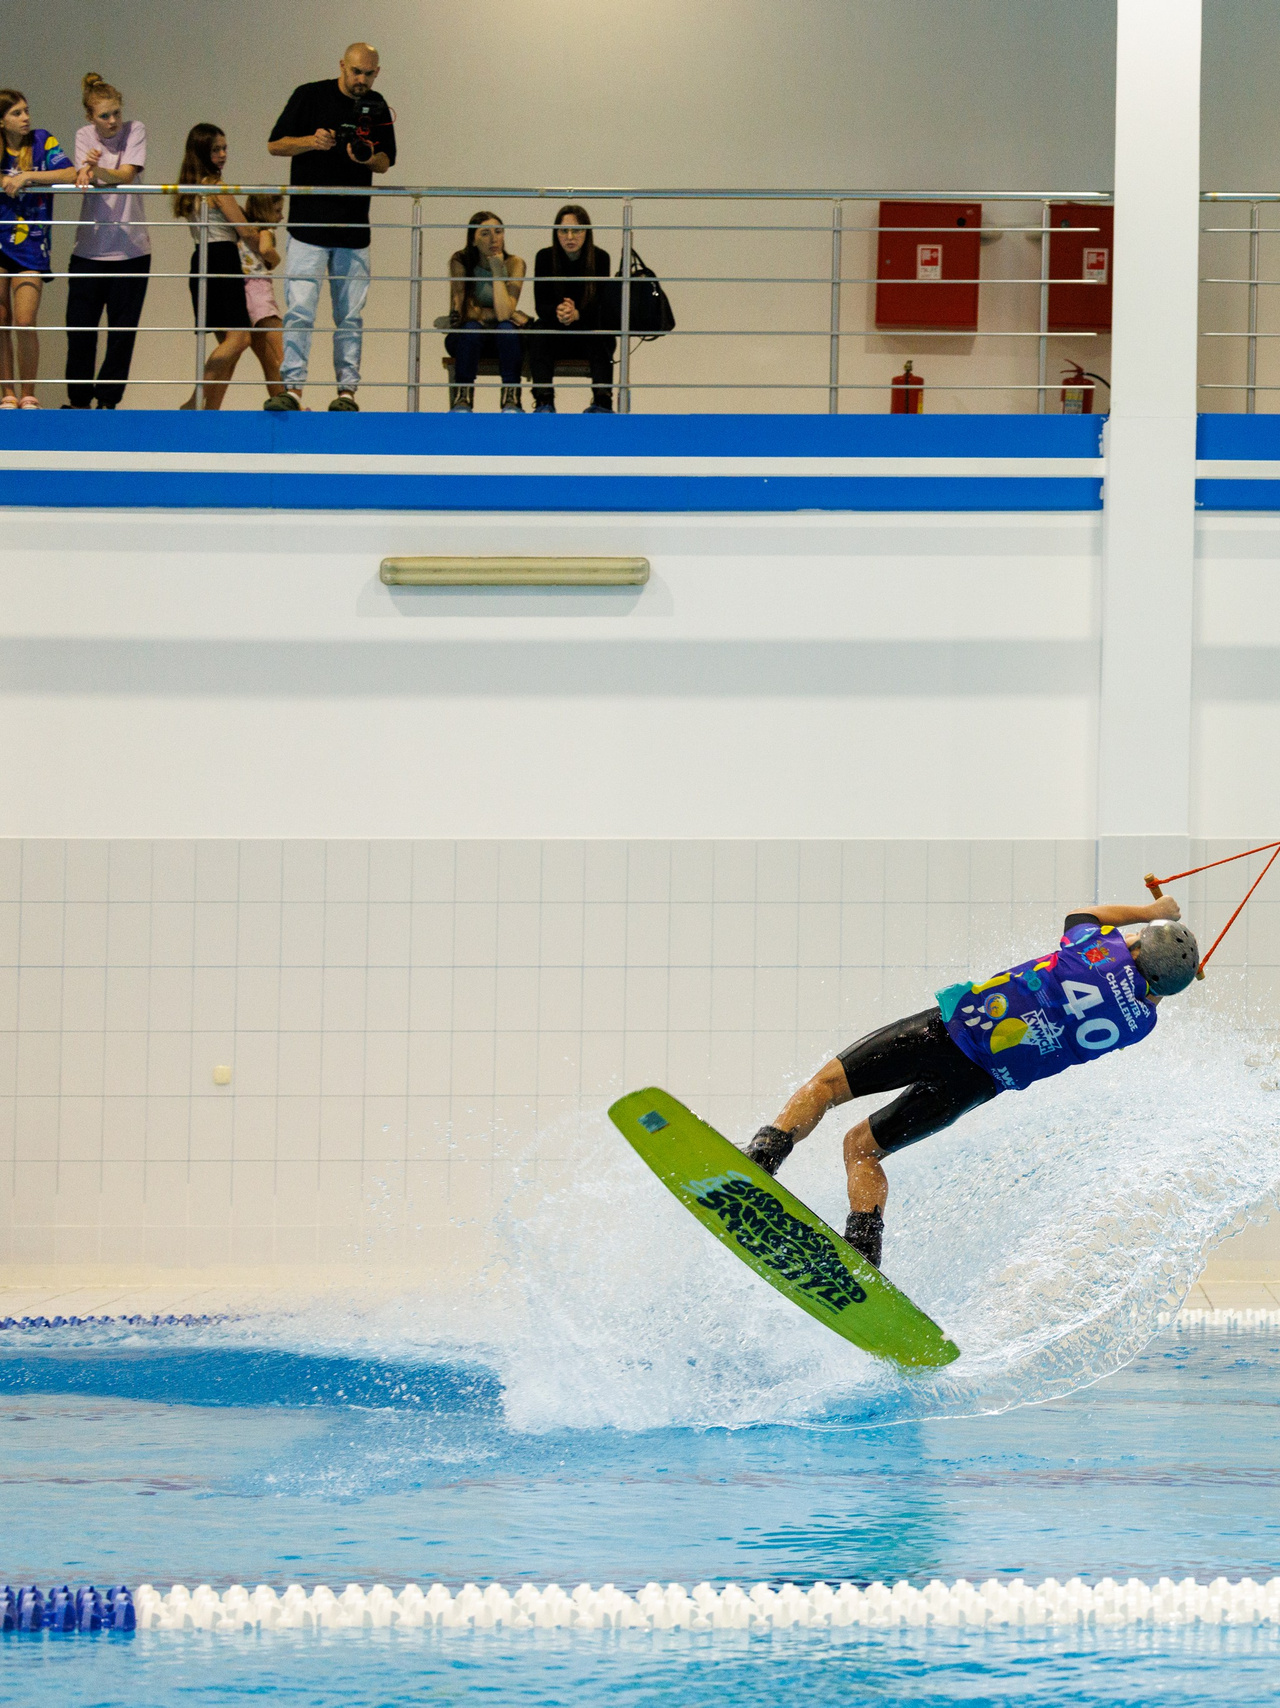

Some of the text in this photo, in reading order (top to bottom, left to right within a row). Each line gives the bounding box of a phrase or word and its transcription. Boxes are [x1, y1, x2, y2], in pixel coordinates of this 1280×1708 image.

[1061, 980, 1120, 1050] 40
[1106, 972, 1138, 1032] CHALLENGE
[1120, 978, 1141, 1018] WINTER
